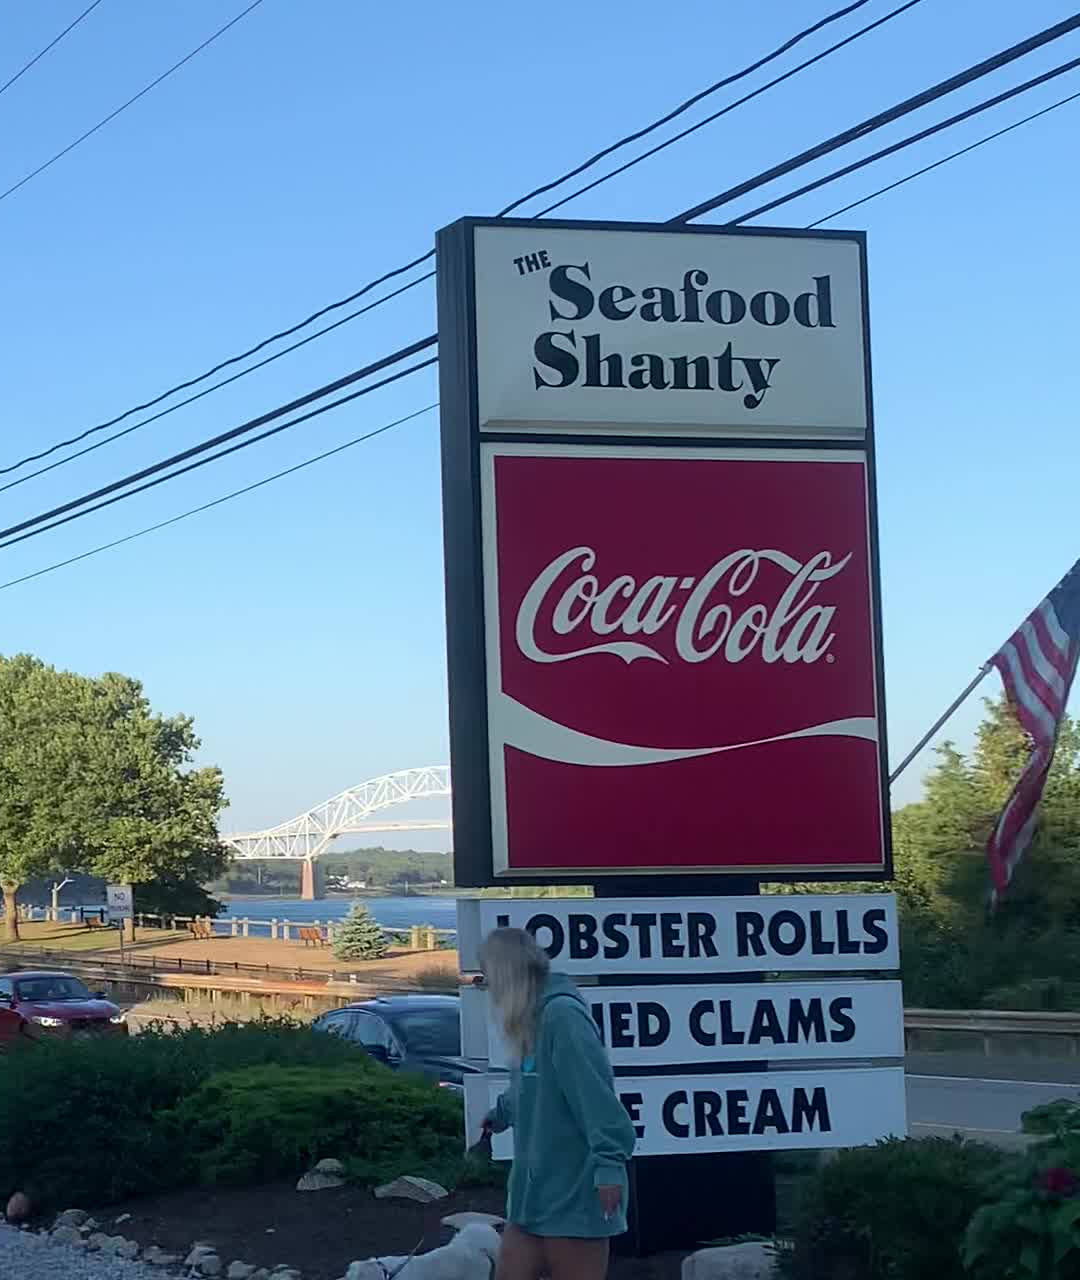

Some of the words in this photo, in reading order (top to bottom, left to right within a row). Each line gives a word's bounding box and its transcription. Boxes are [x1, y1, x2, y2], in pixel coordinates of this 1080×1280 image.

[513, 250, 552, 276] THE
[548, 261, 837, 328] Seafood
[532, 329, 781, 410] Shanty
[515, 546, 853, 664] Coca-Cola
[496, 913, 719, 960] OBSTER
[735, 909, 889, 958] ROLLS
[590, 1001, 671, 1049] IED
[688, 996, 857, 1047] CLAMS
[661, 1086, 832, 1138] CREAM
